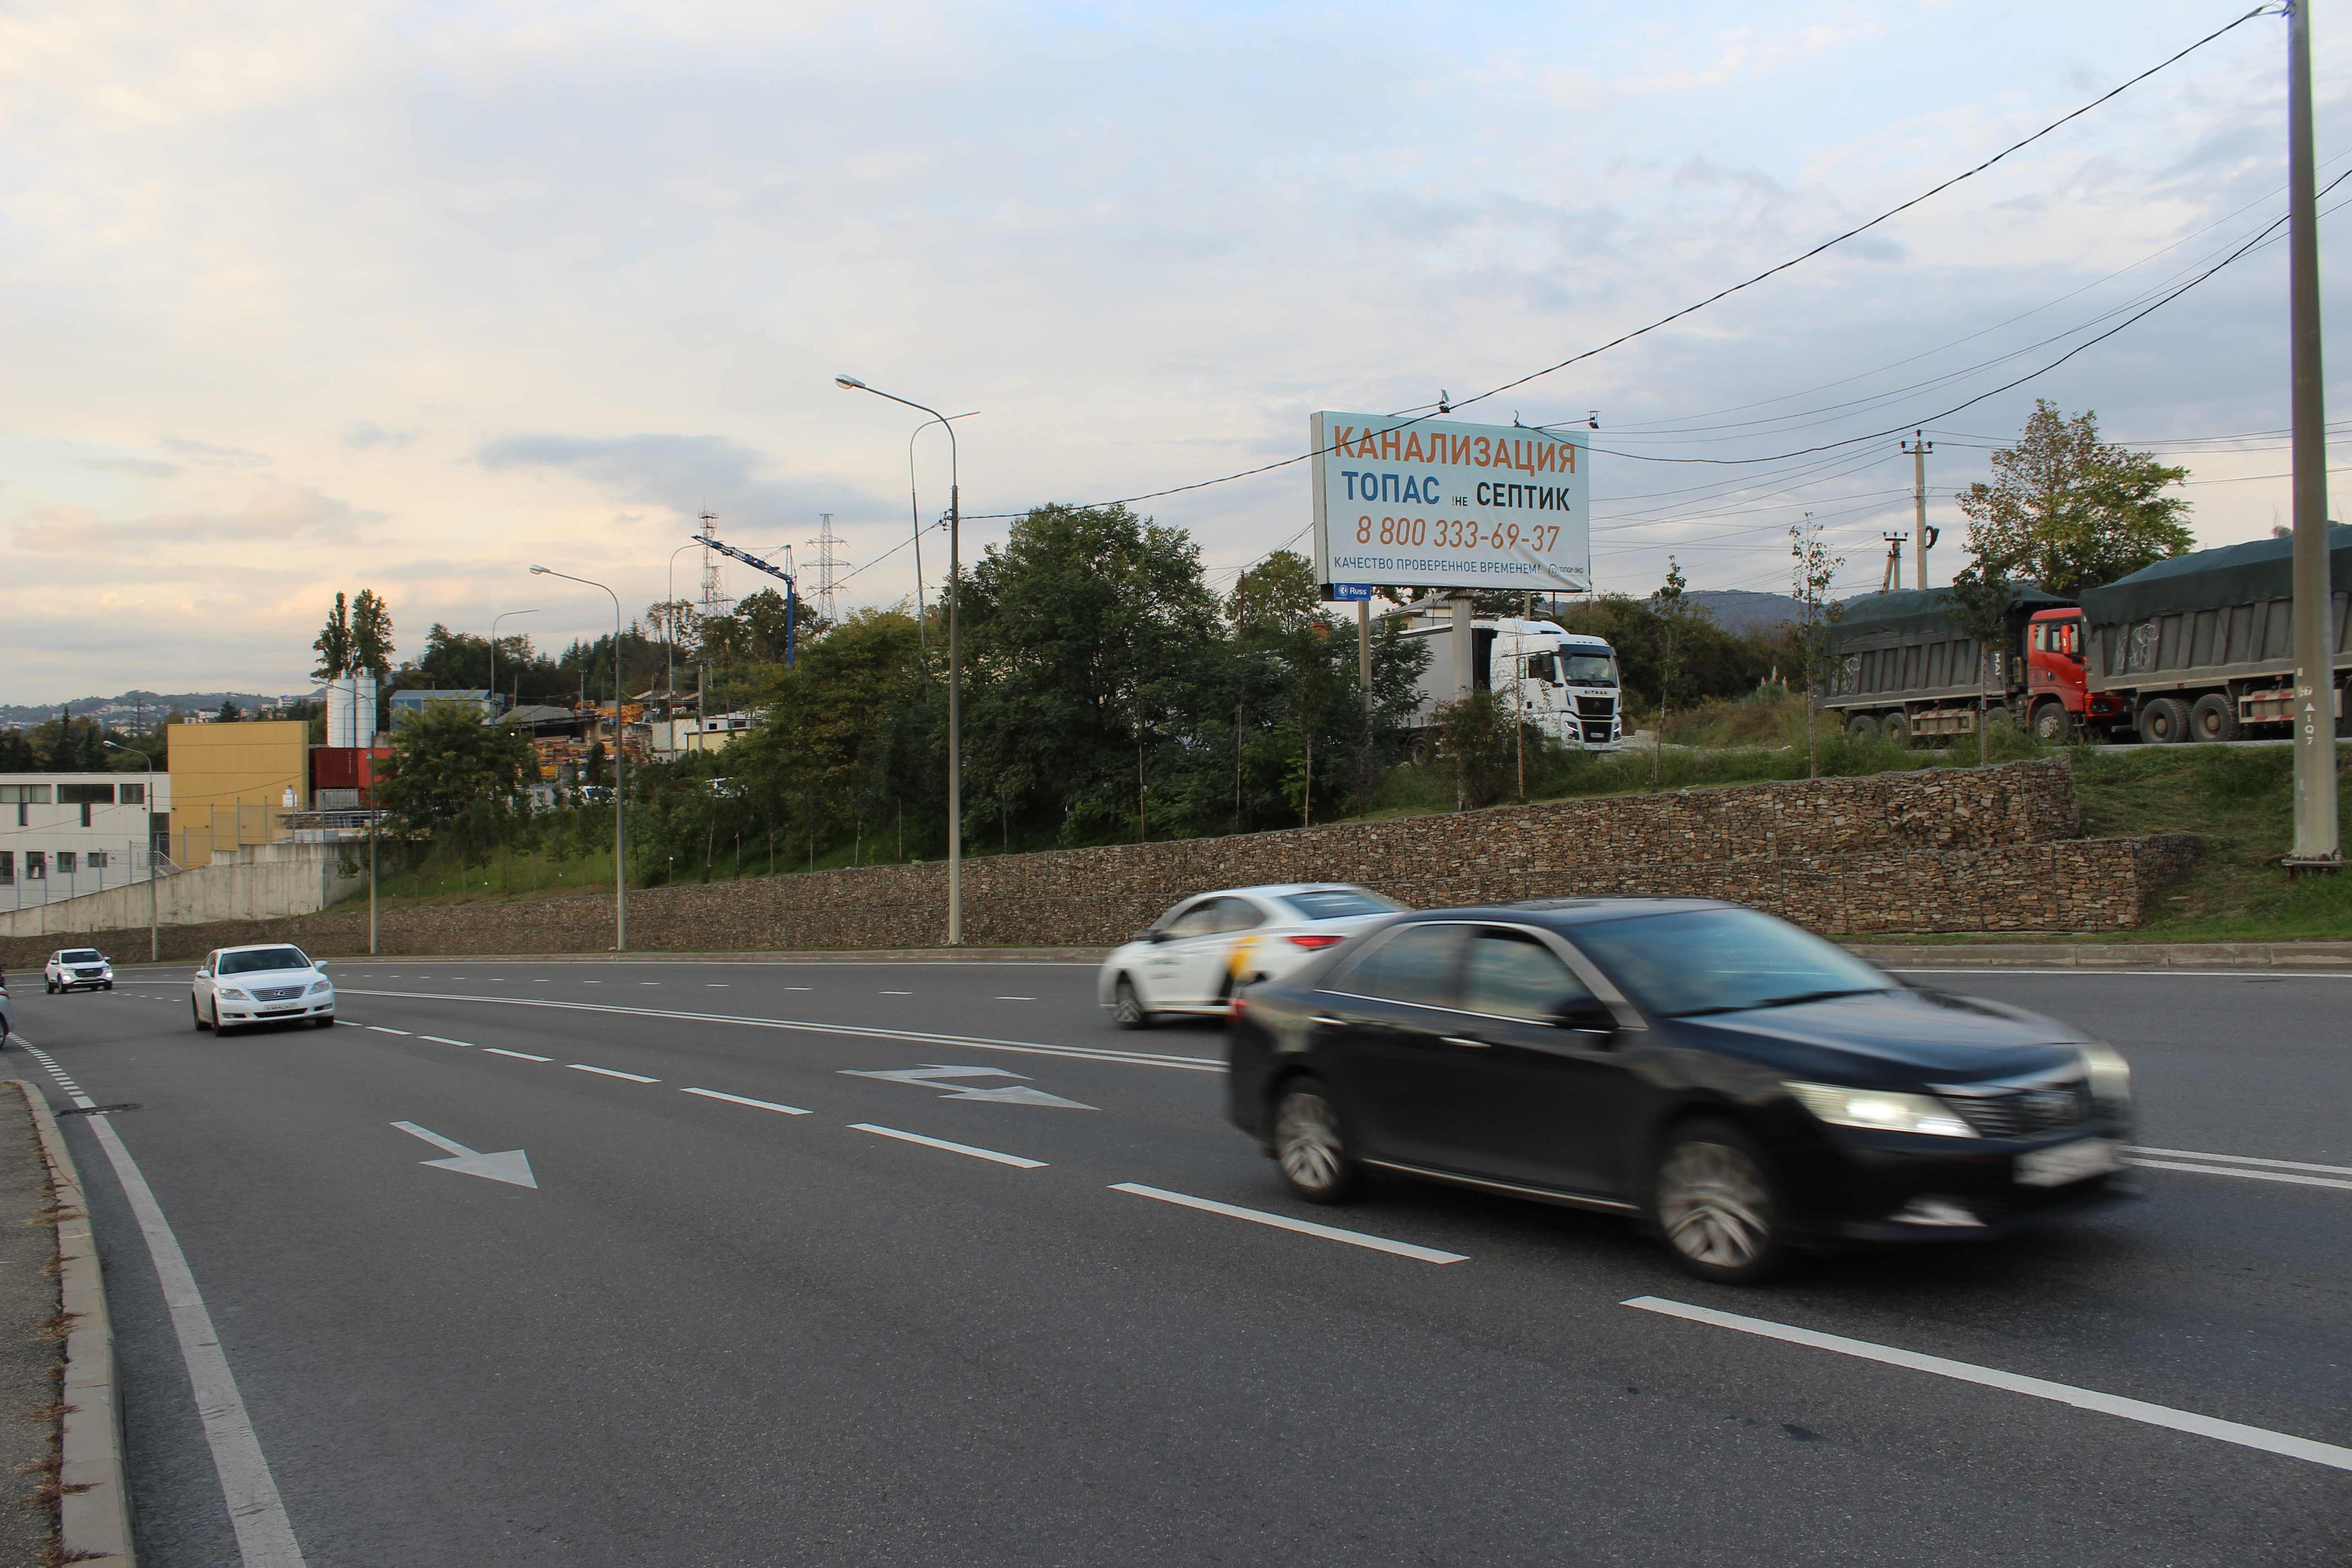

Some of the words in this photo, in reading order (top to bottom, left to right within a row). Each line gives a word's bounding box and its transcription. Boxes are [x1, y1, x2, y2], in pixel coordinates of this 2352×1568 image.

[1335, 426, 1575, 476] КАНАЛИЗАЦИЯ
[1342, 471, 1440, 505] ТОПАС
[1477, 482, 1570, 511] СЕПТИК
[1357, 515, 1372, 544] 8
[1380, 517, 1426, 546] 800
[1434, 519, 1560, 552] 333-69-37
[1334, 557, 1393, 569] КАЧЕСТВО
[1397, 559, 1477, 572] ПРОВЕРЕННОЕ
[1480, 562, 1540, 574] ВРЕМЕНЕМ!
